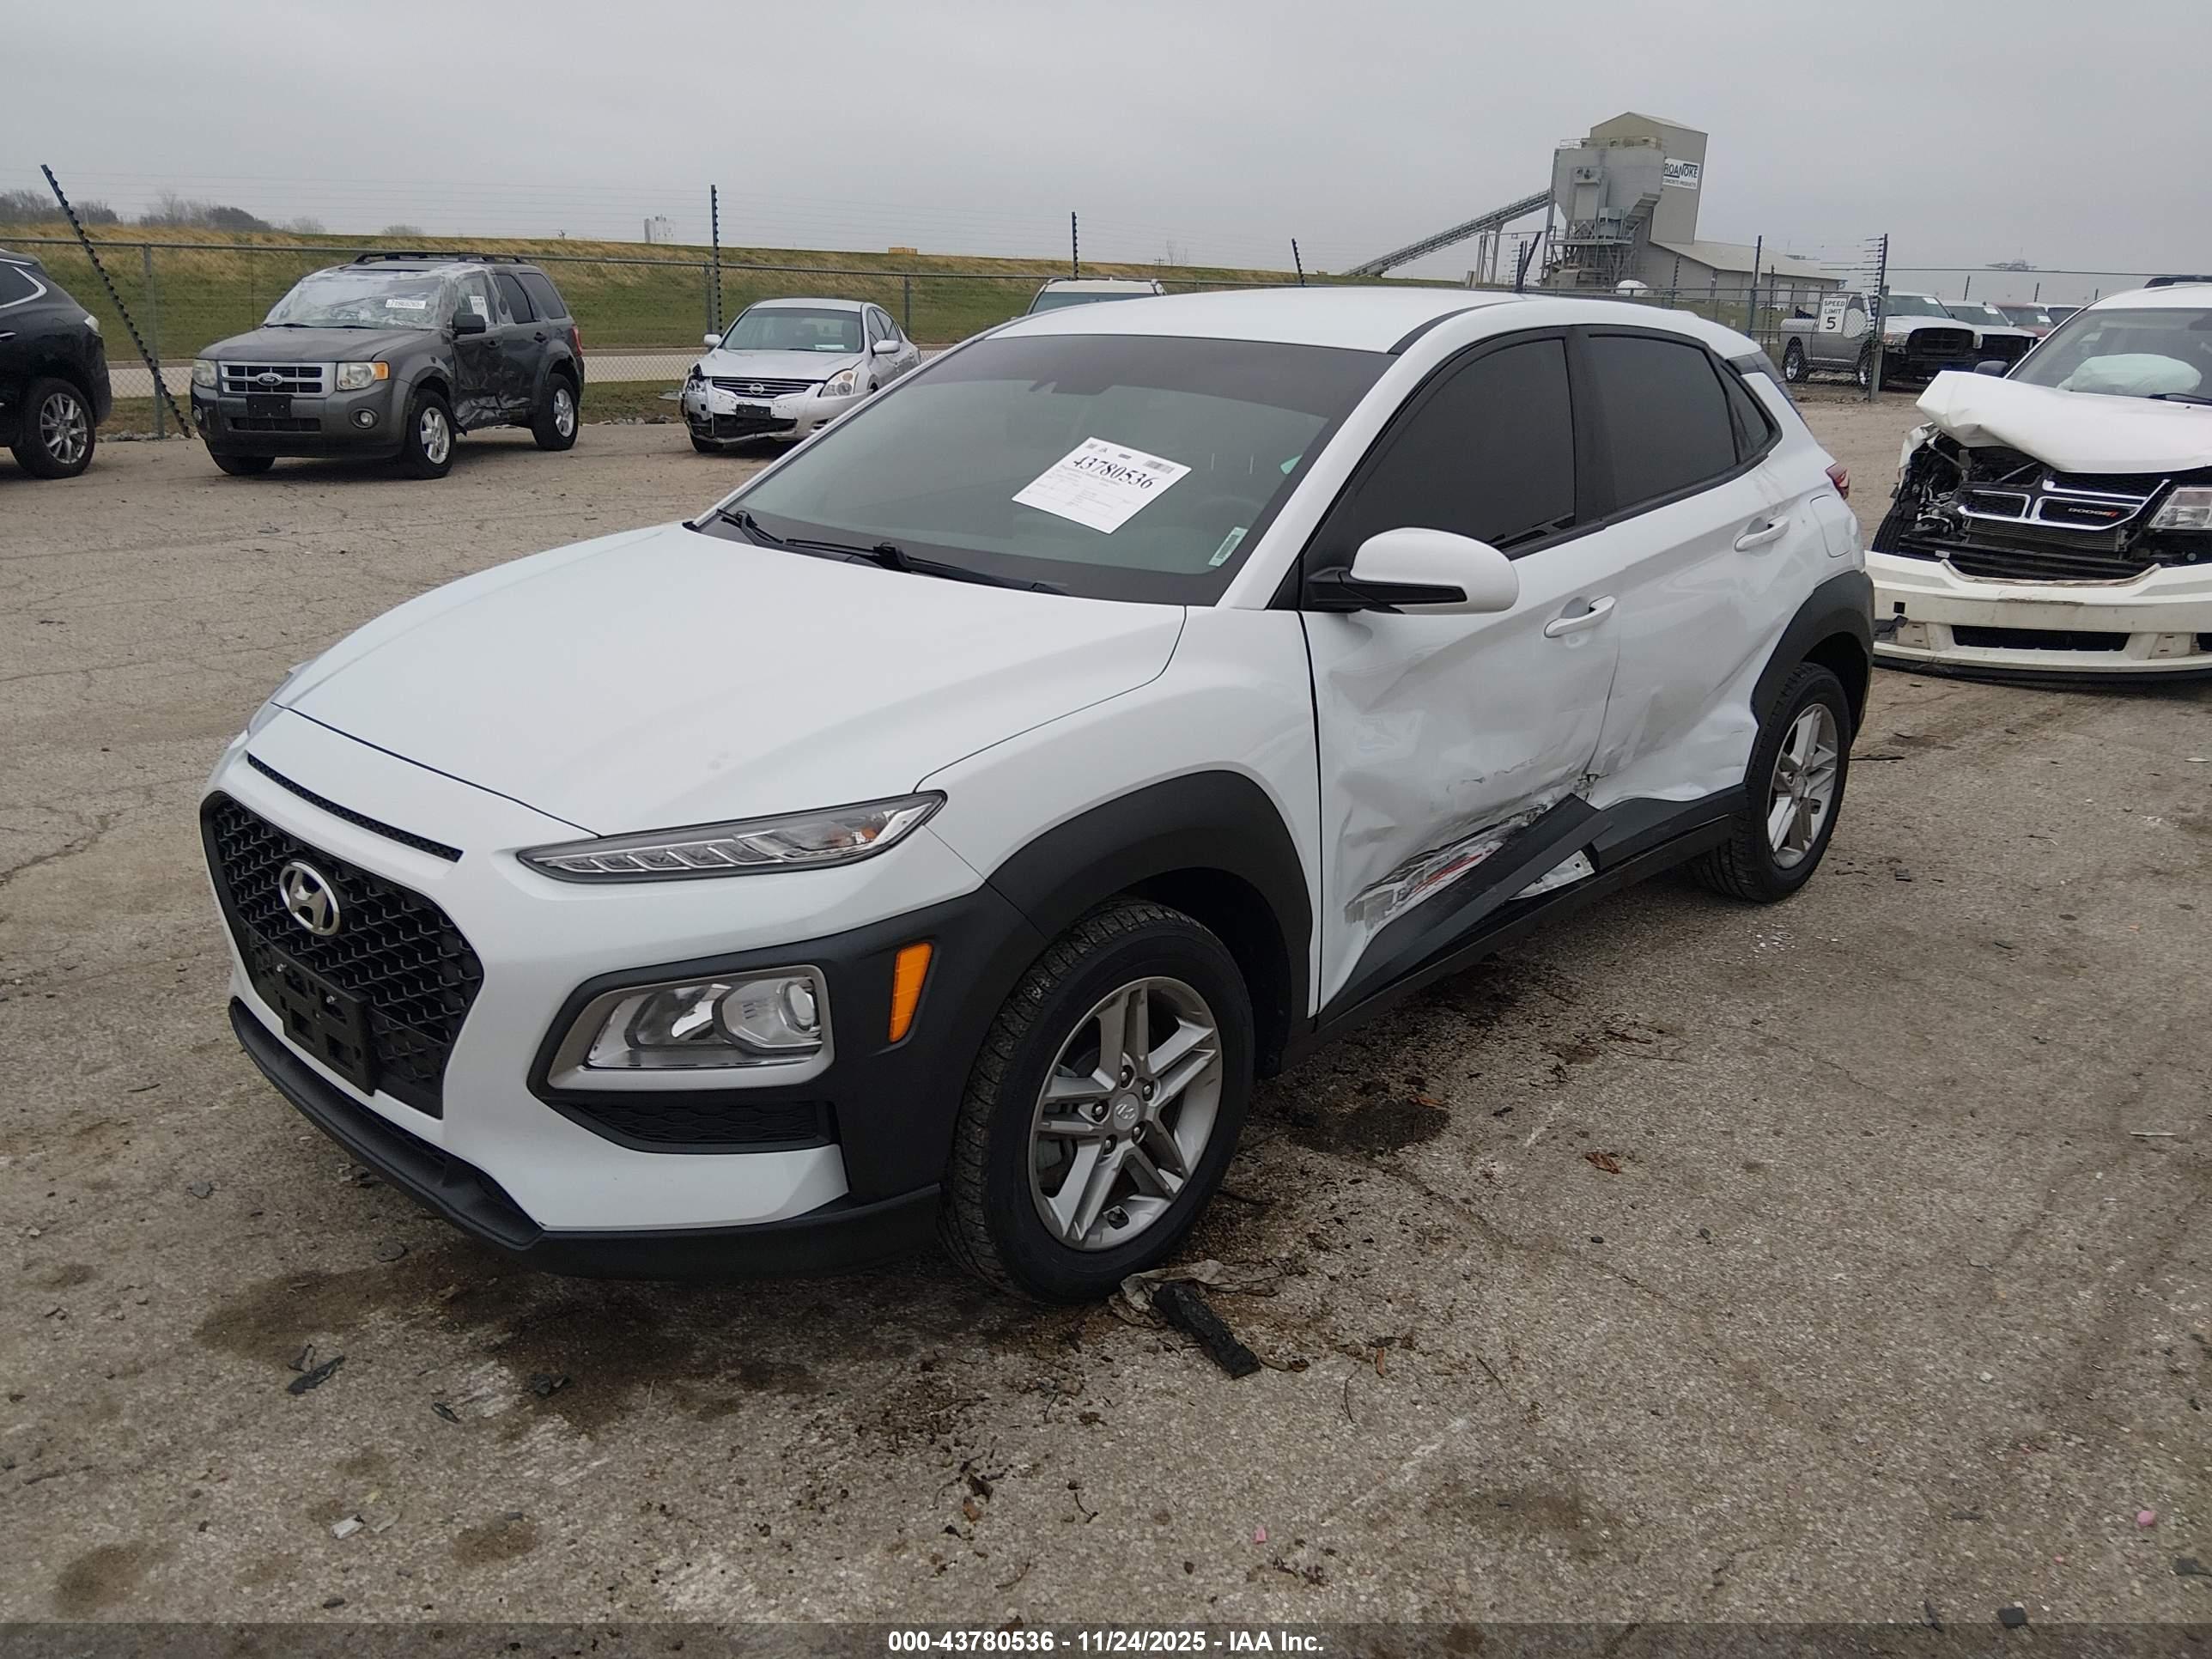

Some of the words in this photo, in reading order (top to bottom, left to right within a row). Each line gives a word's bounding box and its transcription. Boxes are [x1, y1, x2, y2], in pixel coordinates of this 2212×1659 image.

[1664, 163, 1698, 178] ROANOKE
[1826, 317, 1836, 330] 5
[1073, 455, 1160, 489] 43780536
